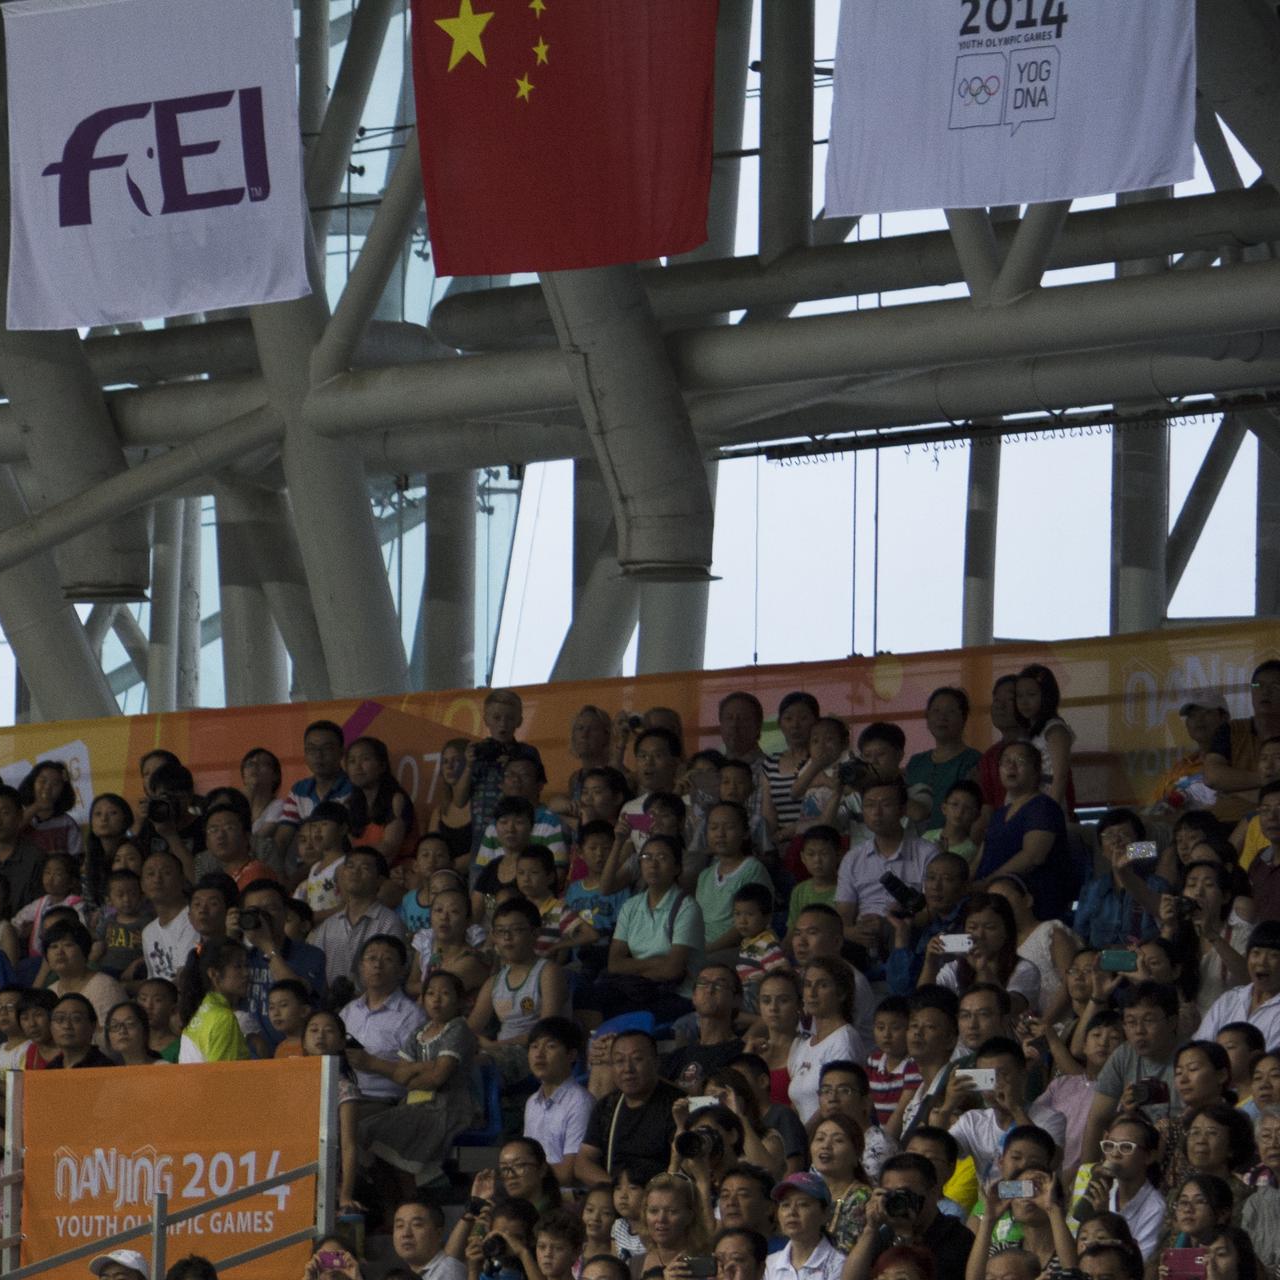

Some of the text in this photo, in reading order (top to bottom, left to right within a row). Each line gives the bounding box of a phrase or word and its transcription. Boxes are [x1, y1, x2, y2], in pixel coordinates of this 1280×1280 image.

[959, 0, 1068, 38] 2014
[985, 34, 1021, 48] OLYMPIC
[1023, 30, 1053, 43] GAMES
[1017, 59, 1051, 84] YOG
[1013, 85, 1049, 110] DNA
[181, 1150, 291, 1211] 2014
[56, 1215, 118, 1238] YOUTH
[209, 1211, 274, 1235] GAMES
